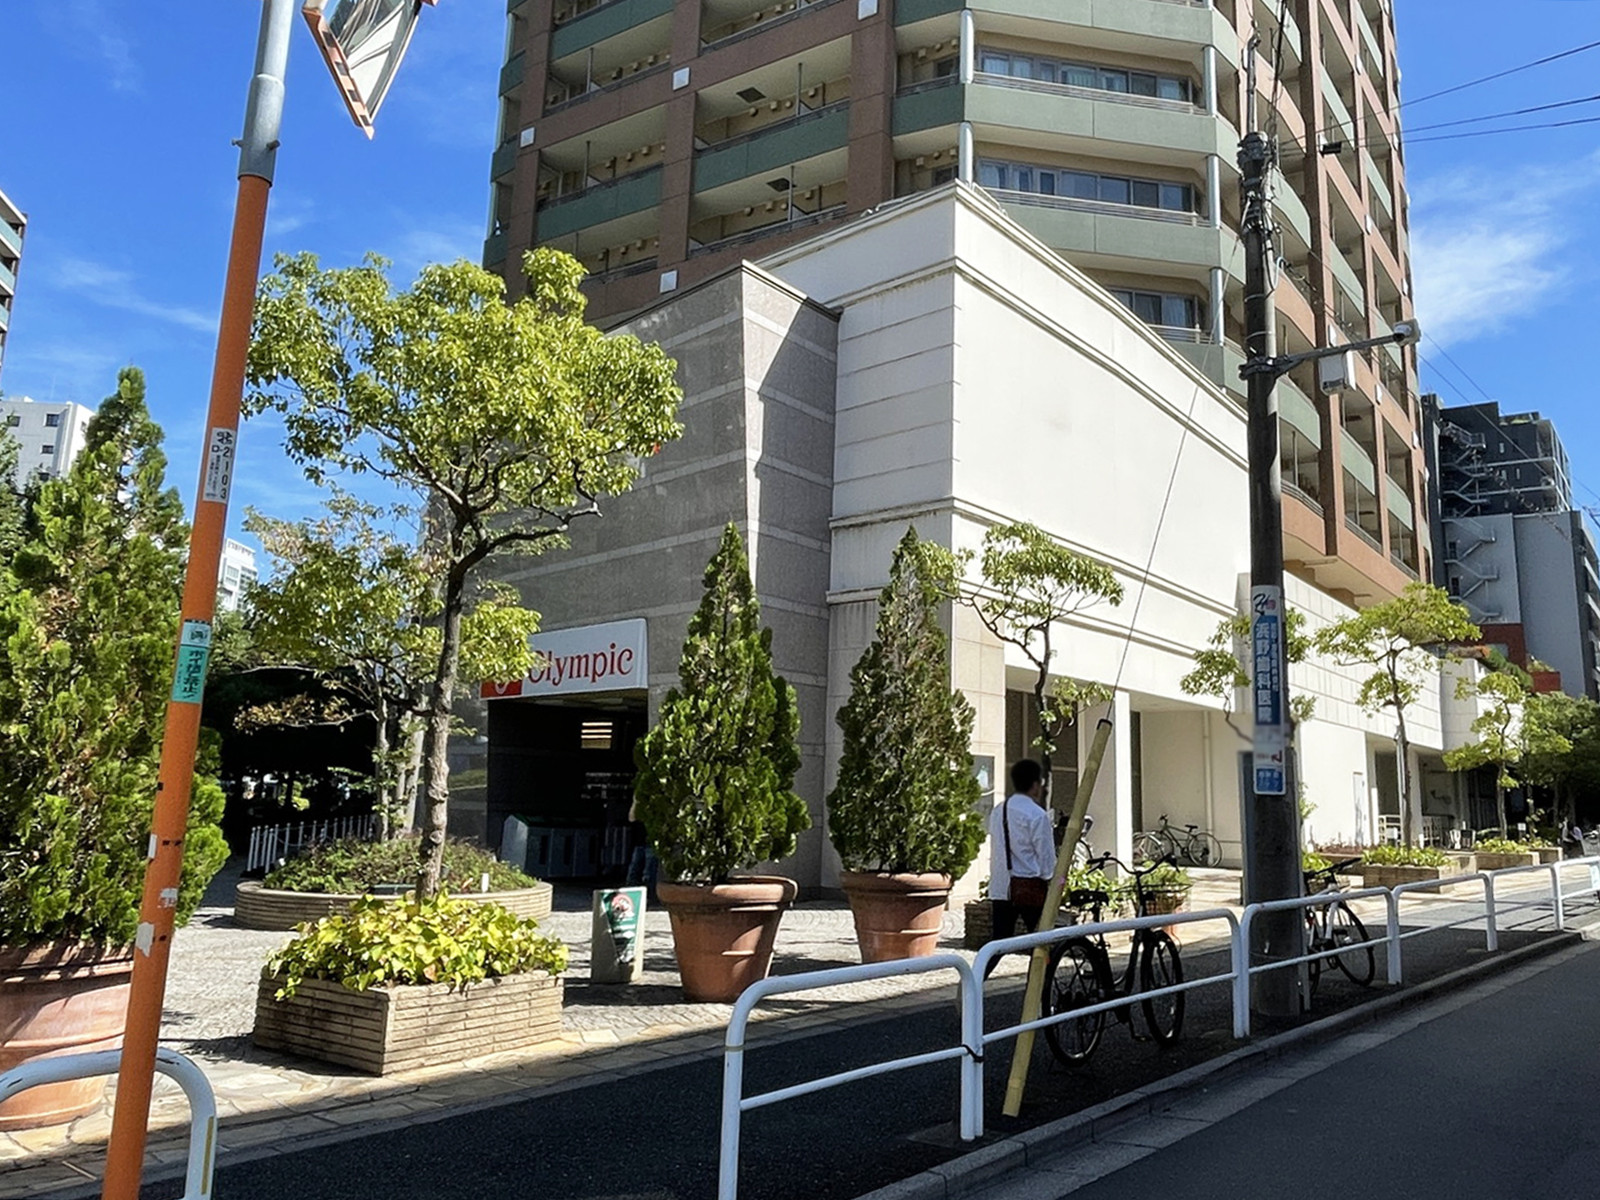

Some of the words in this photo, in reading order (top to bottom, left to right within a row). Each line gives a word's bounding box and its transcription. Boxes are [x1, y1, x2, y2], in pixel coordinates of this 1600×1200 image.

[1255, 622, 1273, 723] 浜野歯科医院
